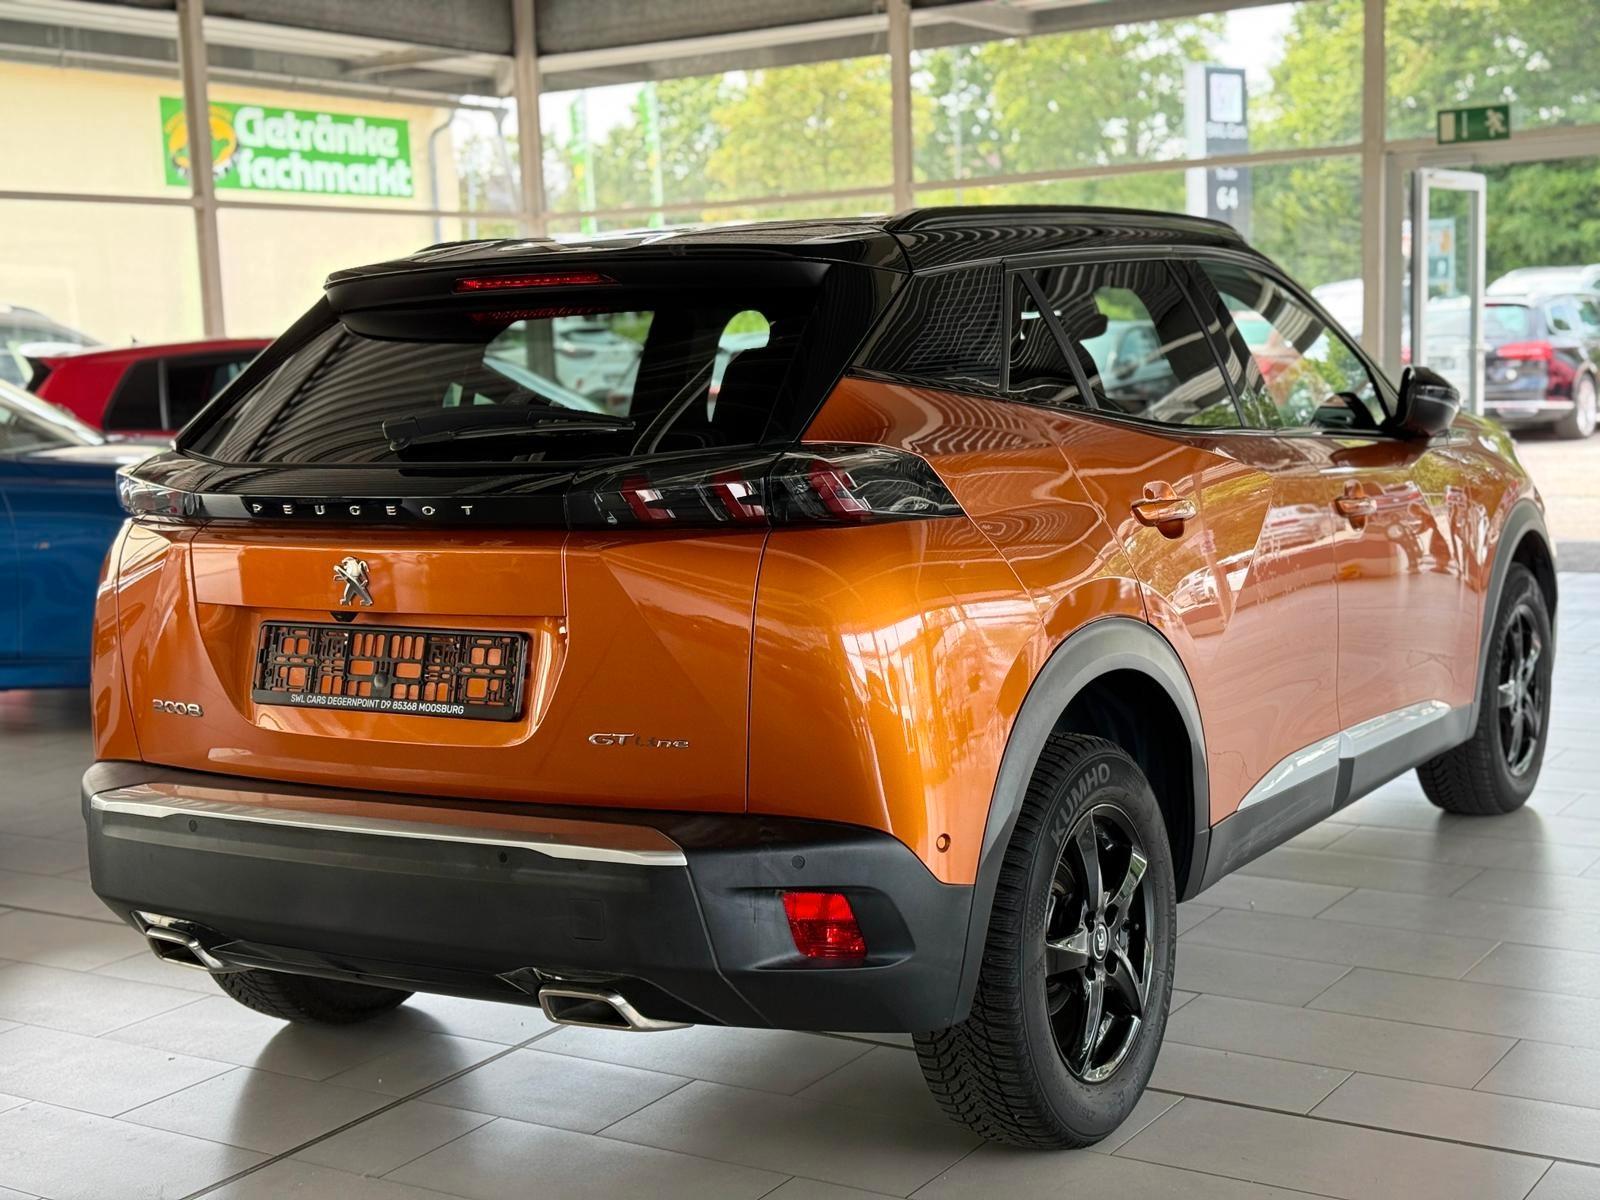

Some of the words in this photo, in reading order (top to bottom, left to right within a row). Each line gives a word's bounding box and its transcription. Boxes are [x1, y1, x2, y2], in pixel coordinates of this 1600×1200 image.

[234, 107, 400, 158] Getränke
[236, 149, 413, 196] fachmarkt
[252, 504, 474, 516] PEUGEOT
[152, 699, 204, 717] 2008
[290, 694, 306, 703] SWL
[306, 695, 326, 704] CARS
[327, 697, 380, 709] DEGERNPOINT
[381, 700, 392, 709] D9
[392, 701, 417, 711] 85368
[418, 703, 465, 715] MOOSBURG
[588, 733, 635, 747] GT
[1050, 763, 1111, 848] KUMHO
